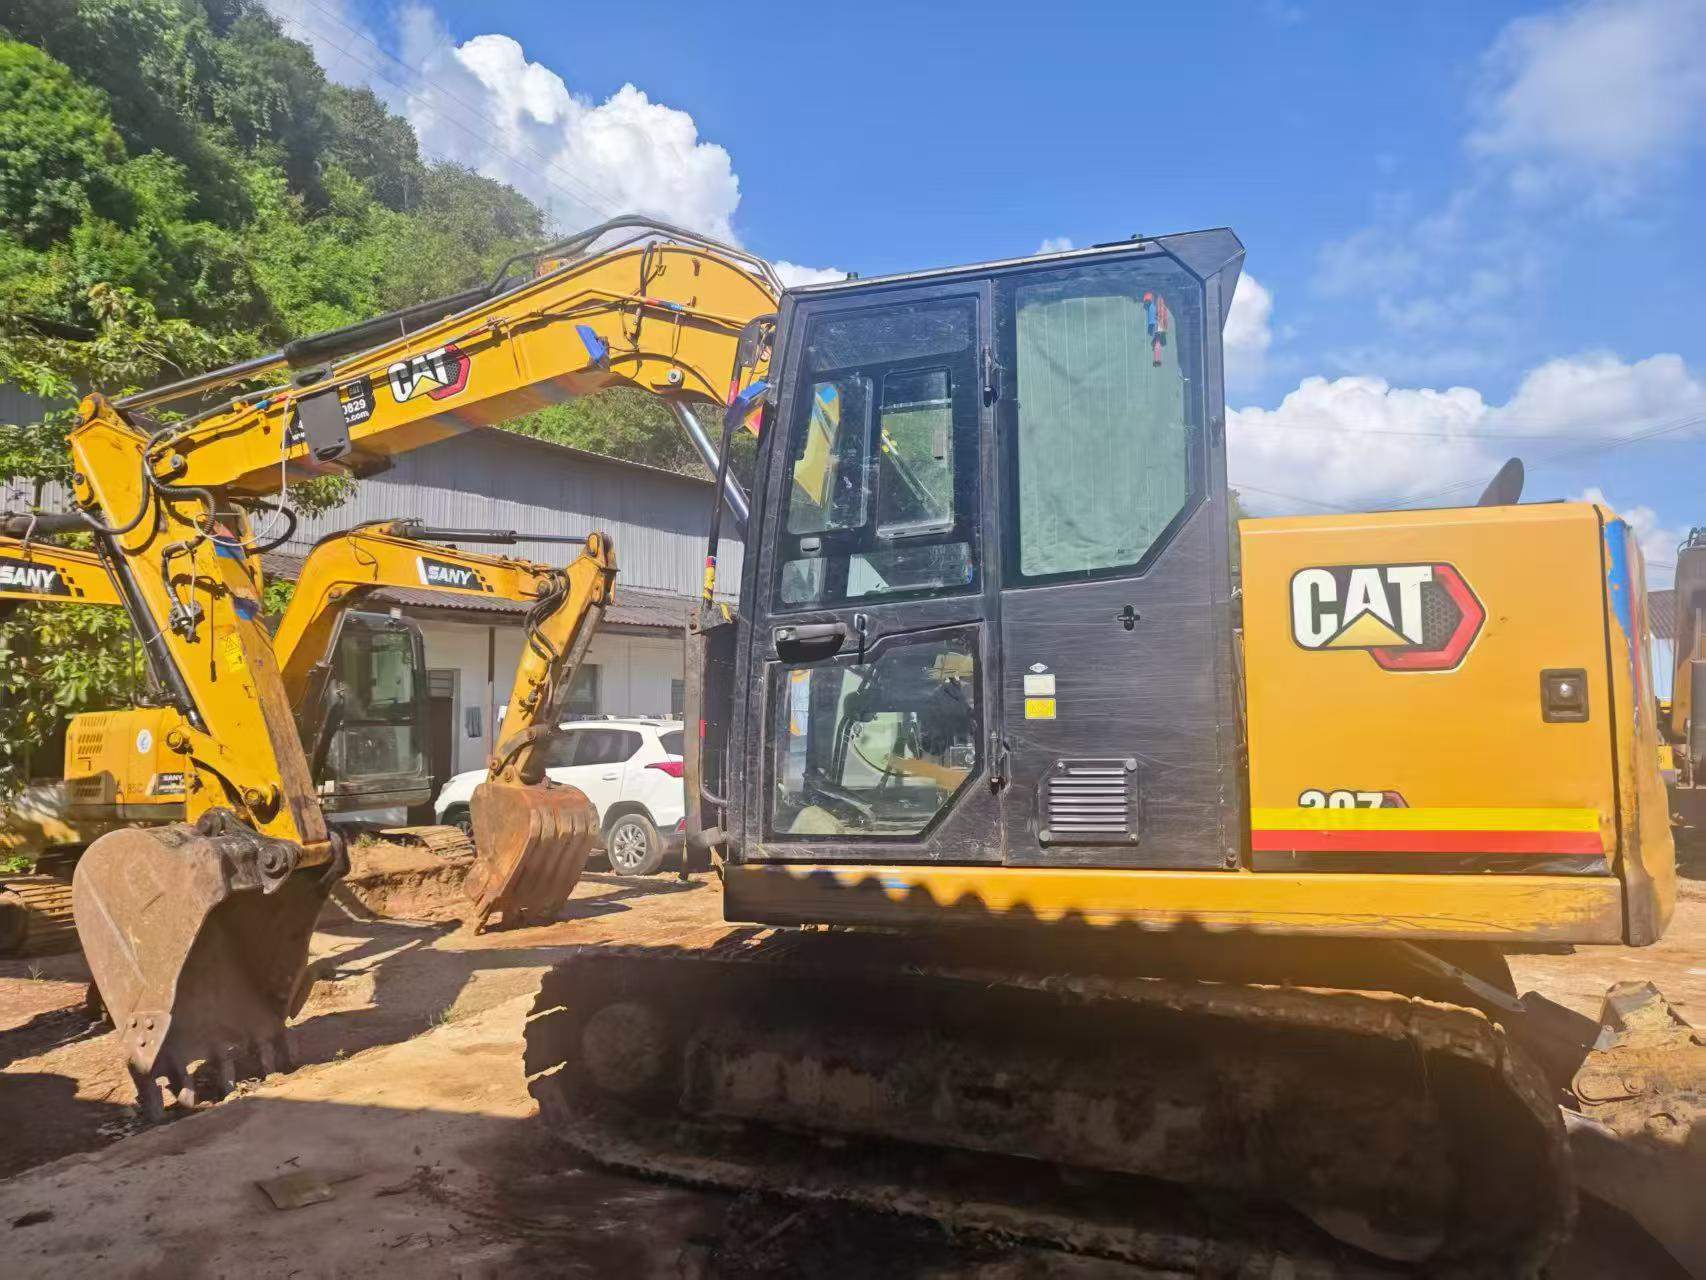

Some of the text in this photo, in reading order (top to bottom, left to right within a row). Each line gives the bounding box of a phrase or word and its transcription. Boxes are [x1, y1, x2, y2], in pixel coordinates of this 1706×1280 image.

[388, 347, 449, 402] CAT
[0, 565, 57, 588] SANY
[428, 565, 472, 585] SANY
[1292, 565, 1433, 648] CAT
